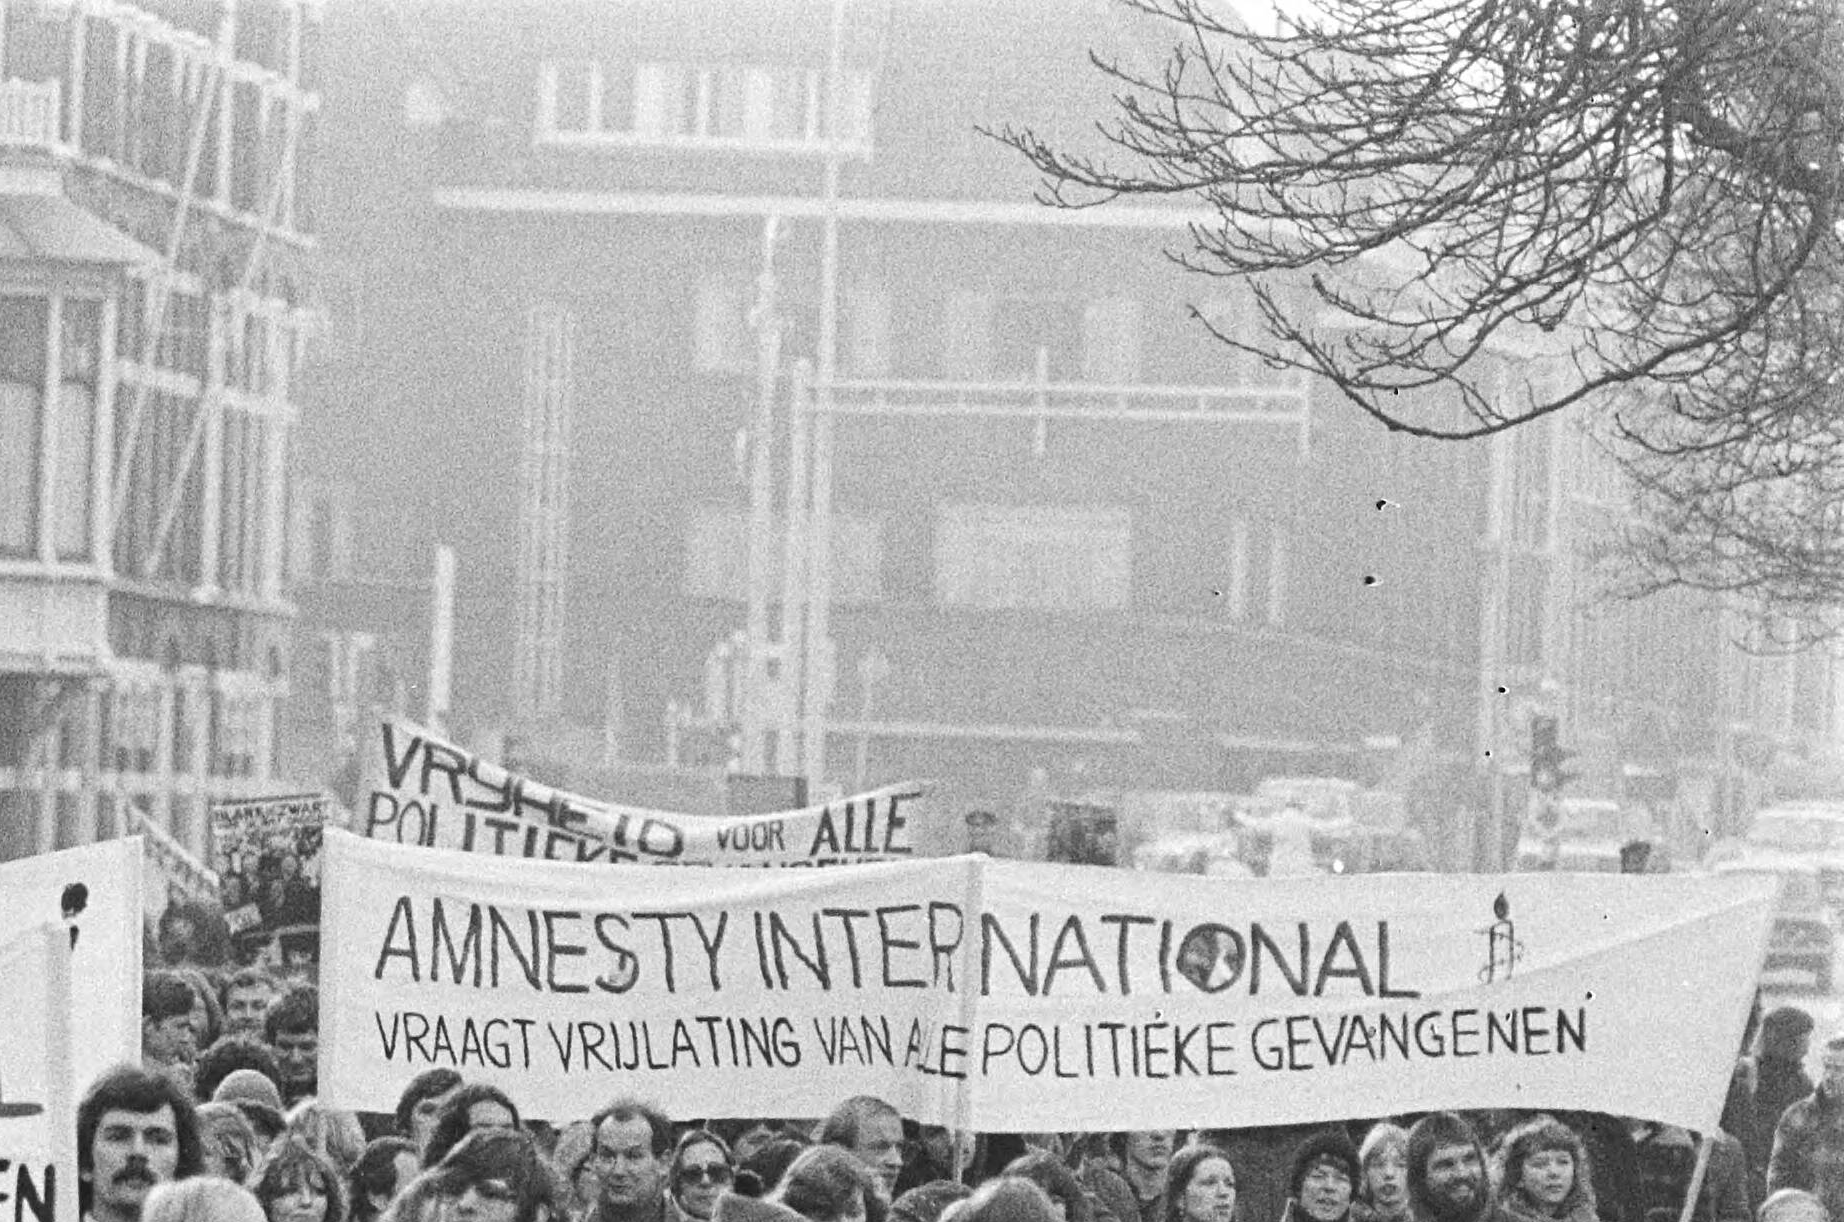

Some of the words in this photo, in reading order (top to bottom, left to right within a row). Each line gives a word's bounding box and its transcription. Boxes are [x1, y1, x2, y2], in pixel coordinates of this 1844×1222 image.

[716, 820, 785, 852] VOOR
[809, 791, 922, 856] ALLE
[374, 895, 729, 995] AMNESTY
[755, 898, 1421, 998] INTERNATIONAL
[376, 1010, 534, 1069] VRAAGT
[547, 1013, 801, 1072] VRIJLATING
[820, 1014, 893, 1067] VAN
[982, 1020, 1238, 1078] POLITIEKE
[1250, 1006, 1586, 1073] GEVANGENEN
